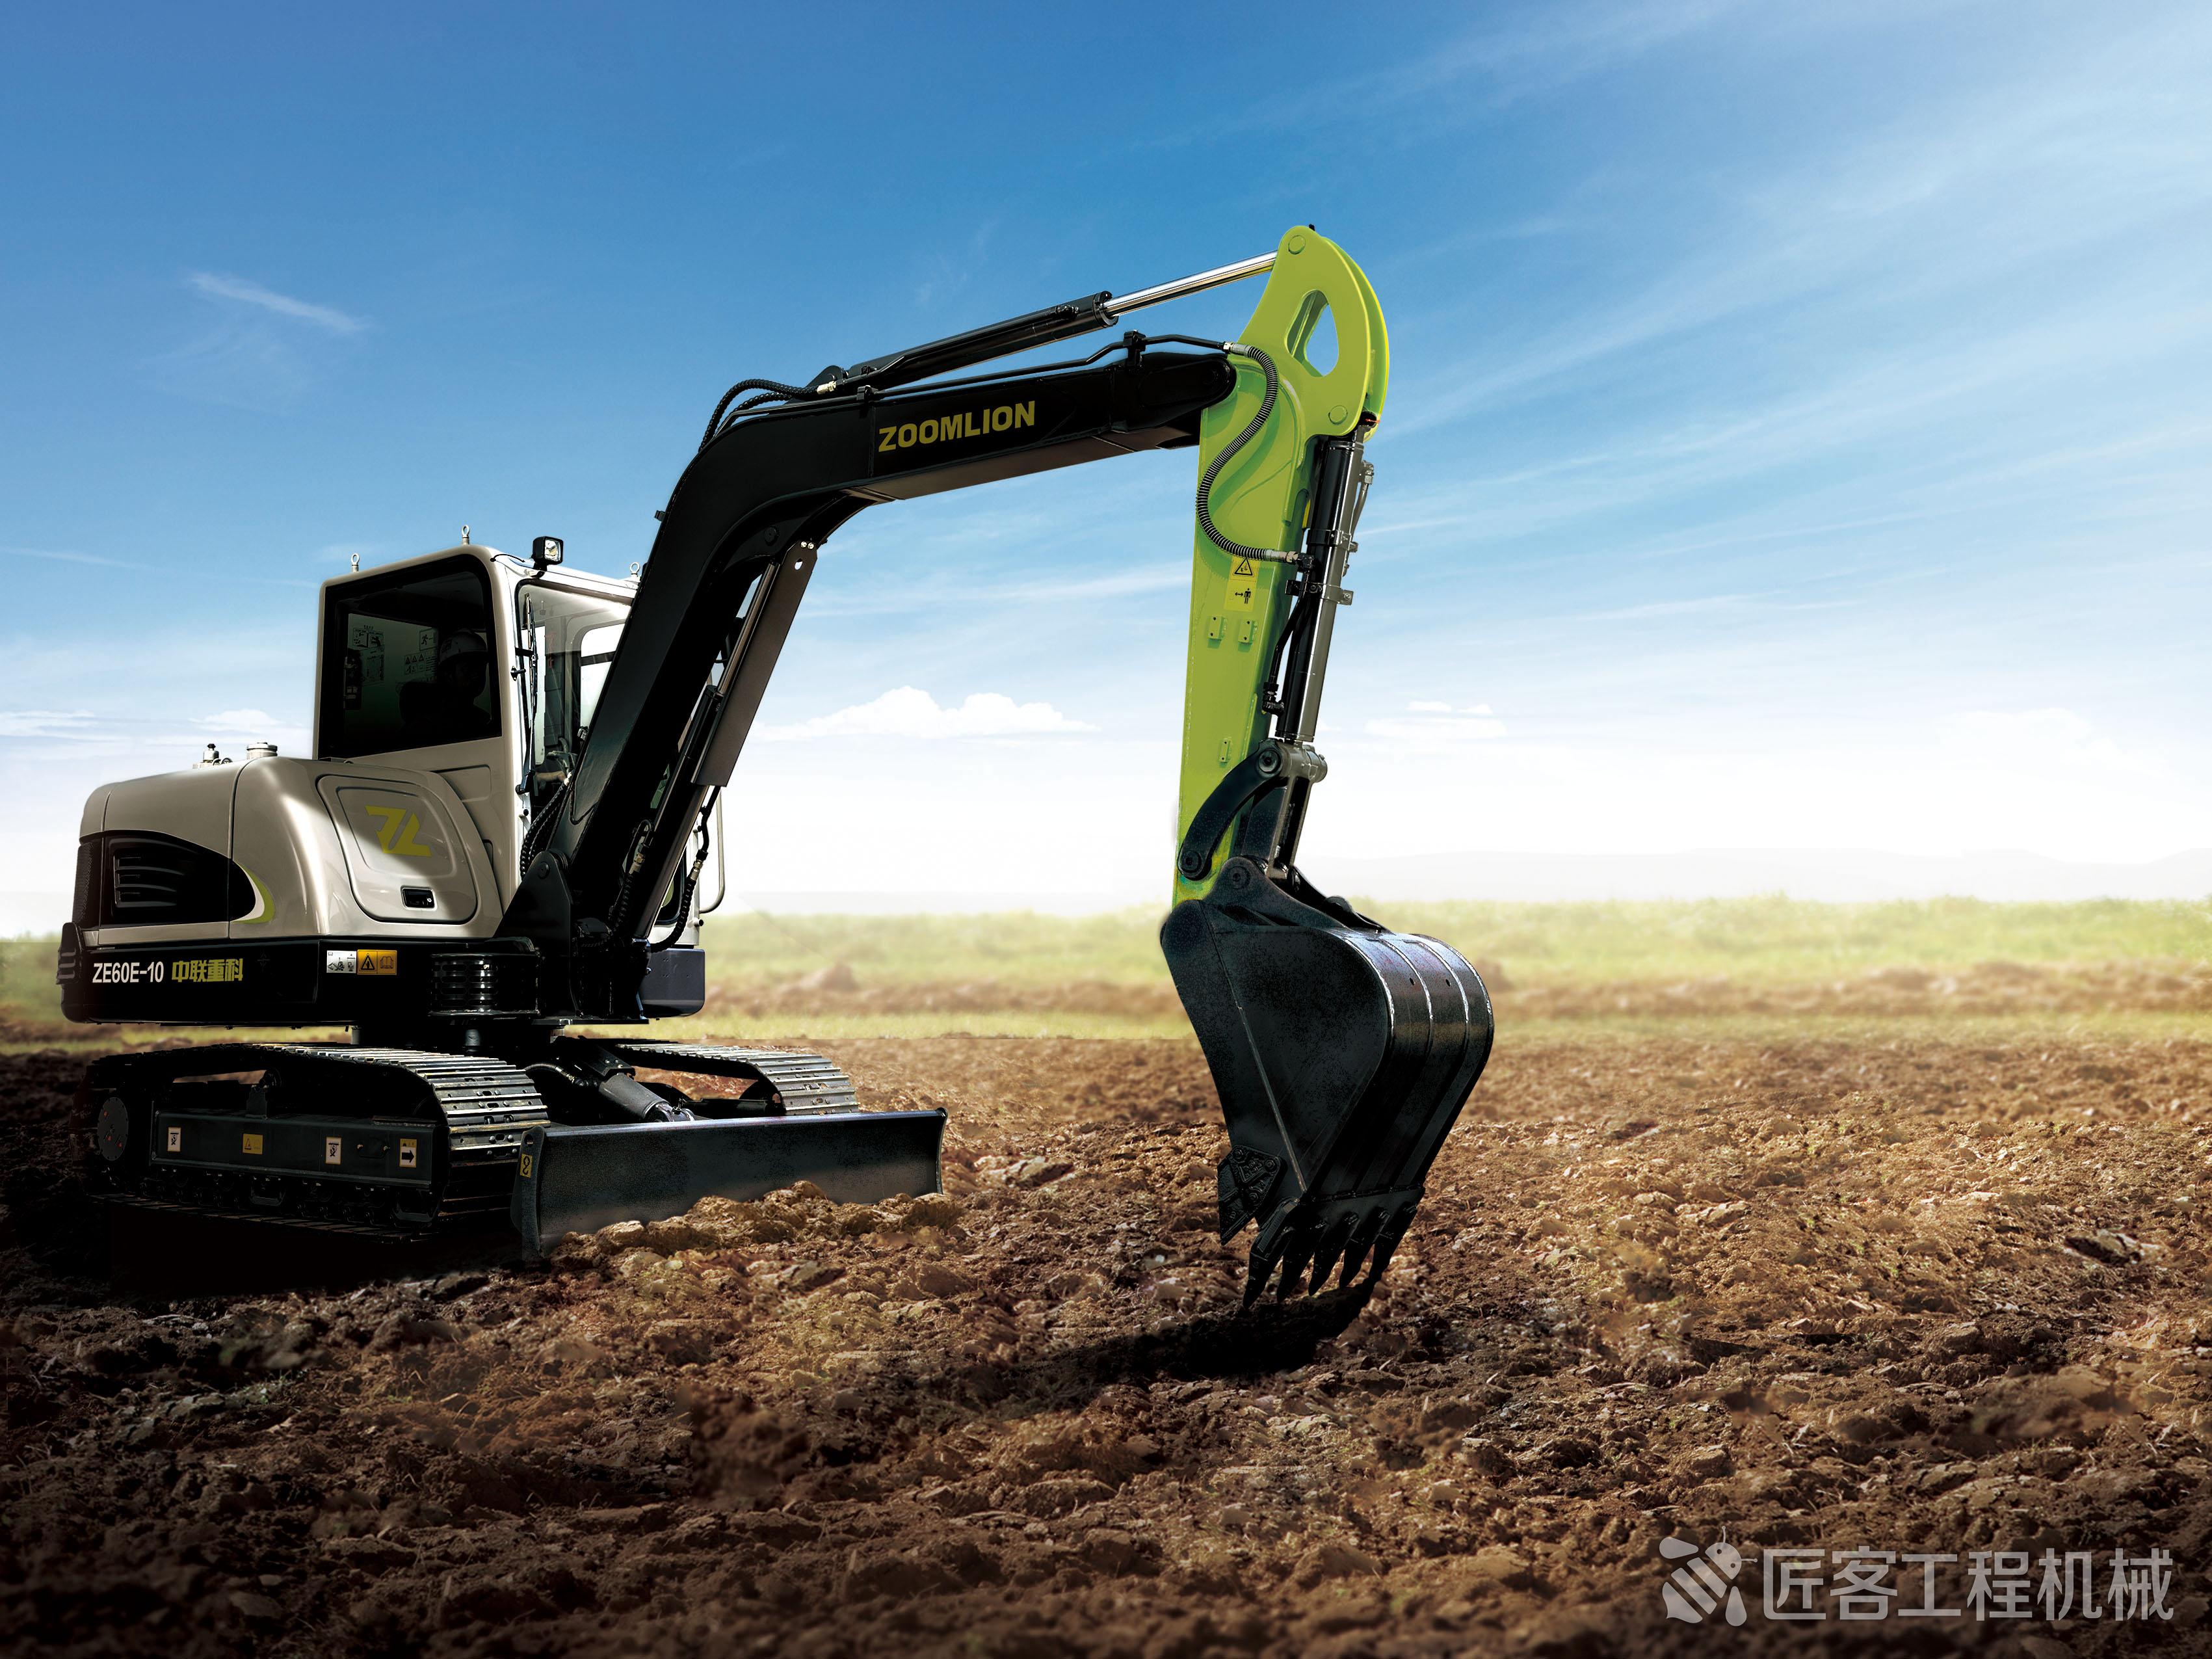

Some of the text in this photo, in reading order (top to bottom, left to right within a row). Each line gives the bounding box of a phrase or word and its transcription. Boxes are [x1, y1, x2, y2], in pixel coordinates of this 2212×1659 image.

[878, 400, 1035, 452] ZOOMLION
[92, 958, 244, 983] ZE60E-10 中联重科
